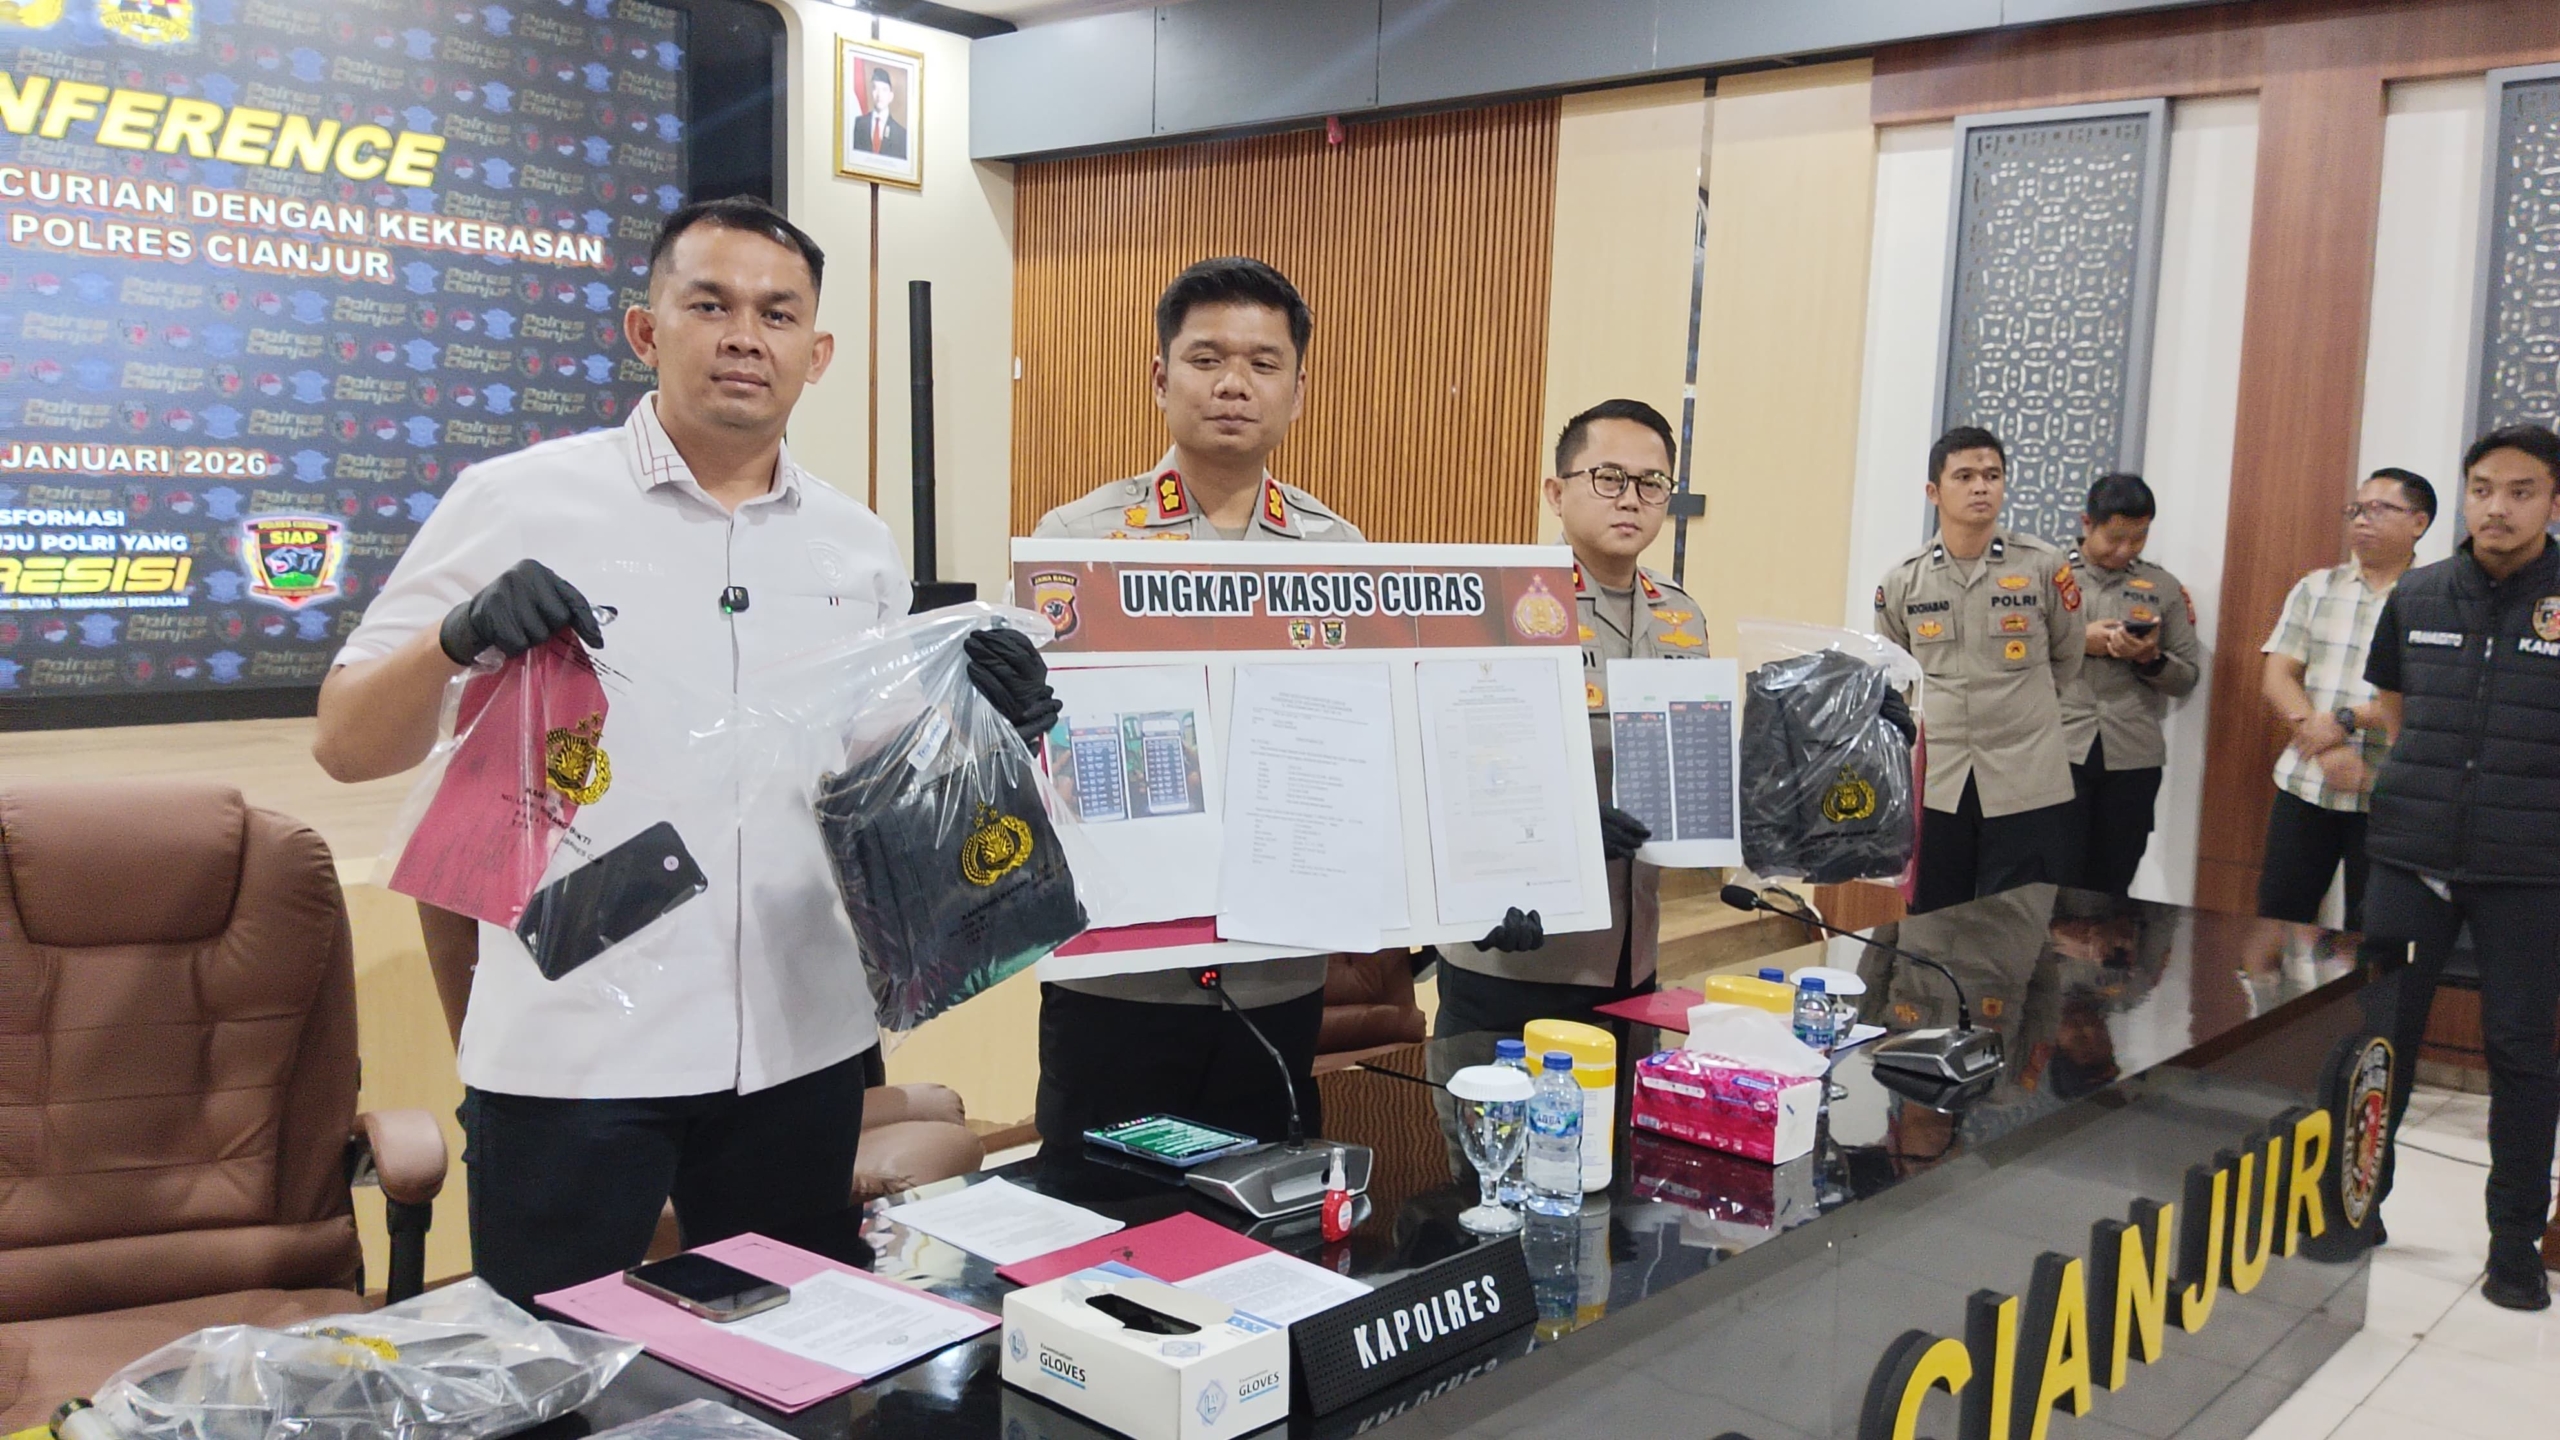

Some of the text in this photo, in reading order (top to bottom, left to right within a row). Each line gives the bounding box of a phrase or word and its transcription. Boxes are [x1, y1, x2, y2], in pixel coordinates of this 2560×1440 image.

[0, 167, 603, 264] CURIAN DENGAN KEKERASAN
[12, 213, 390, 279] POLRES CIANJUR
[1, 443, 268, 476] JANUARI 2026
[0, 508, 125, 527] SFORMASI
[41, 534, 116, 551] POLRI
[121, 533, 189, 551] YANG
[269, 530, 318, 545] SIAP
[1122, 573, 1483, 614] UNGKAP KASUS CURAS
[1991, 595, 2037, 608] POLRI
[2123, 589, 2159, 605] POLRI
[1893, 1108, 2333, 1440] CIANJUR
[1353, 1275, 1500, 1369] KAPOLRES
[1040, 1352, 1087, 1383] GLOVES
[1239, 1371, 1280, 1397] GLOVES
